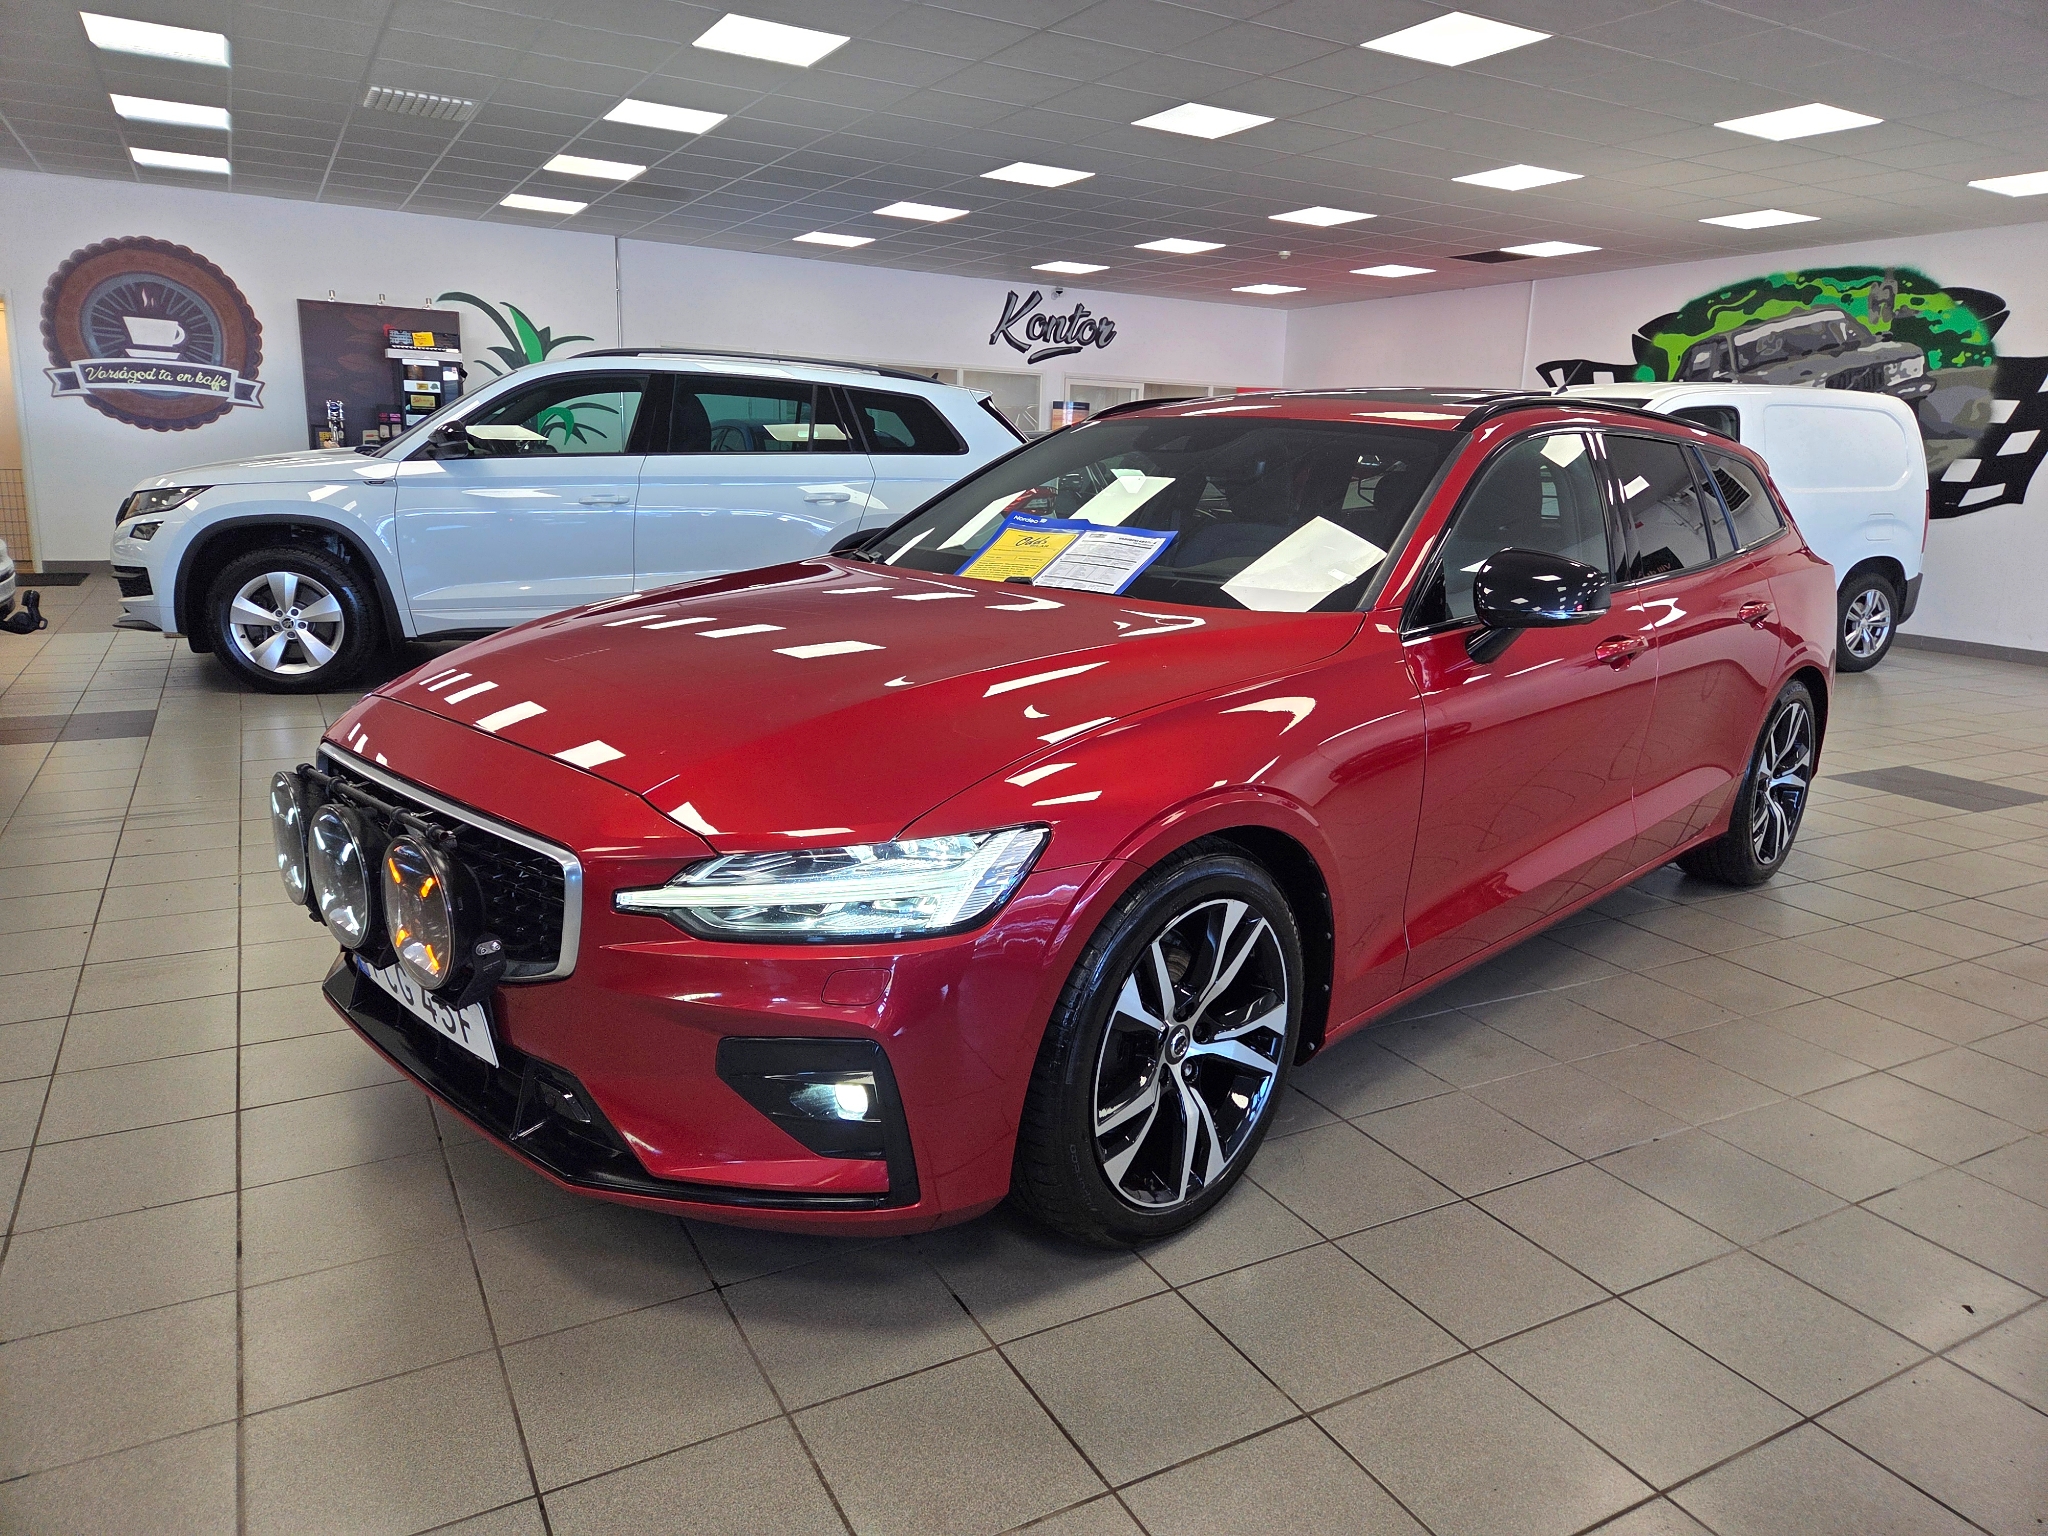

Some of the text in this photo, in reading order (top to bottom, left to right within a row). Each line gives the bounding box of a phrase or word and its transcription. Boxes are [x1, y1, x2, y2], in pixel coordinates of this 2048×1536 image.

[989, 290, 1117, 354] Kontor
[158, 368, 174, 381] ta
[177, 372, 194, 382] en
[196, 371, 228, 391] kaffe
